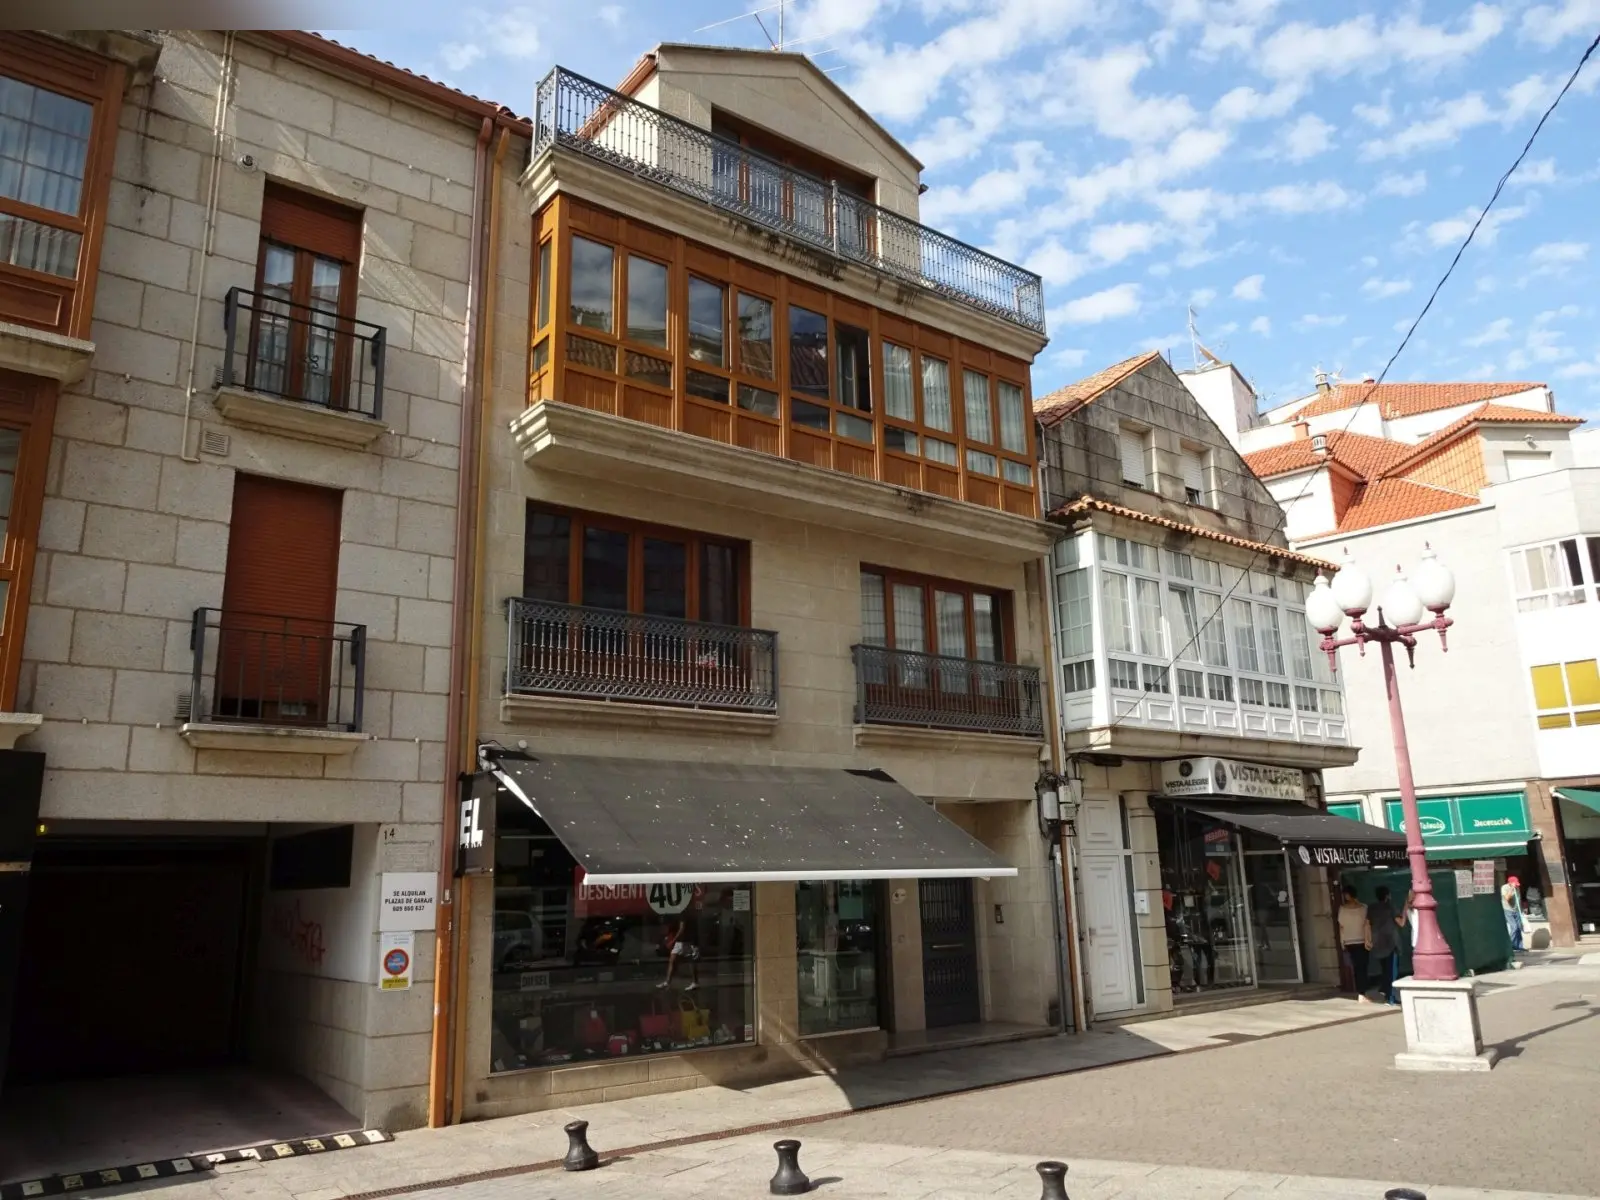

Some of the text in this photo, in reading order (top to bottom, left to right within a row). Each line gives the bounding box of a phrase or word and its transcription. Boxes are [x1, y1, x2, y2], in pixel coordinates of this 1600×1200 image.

[384, 828, 395, 840] 14
[1374, 850, 1409, 860] ZAPATILLA
[578, 883, 645, 901] DESCUENT
